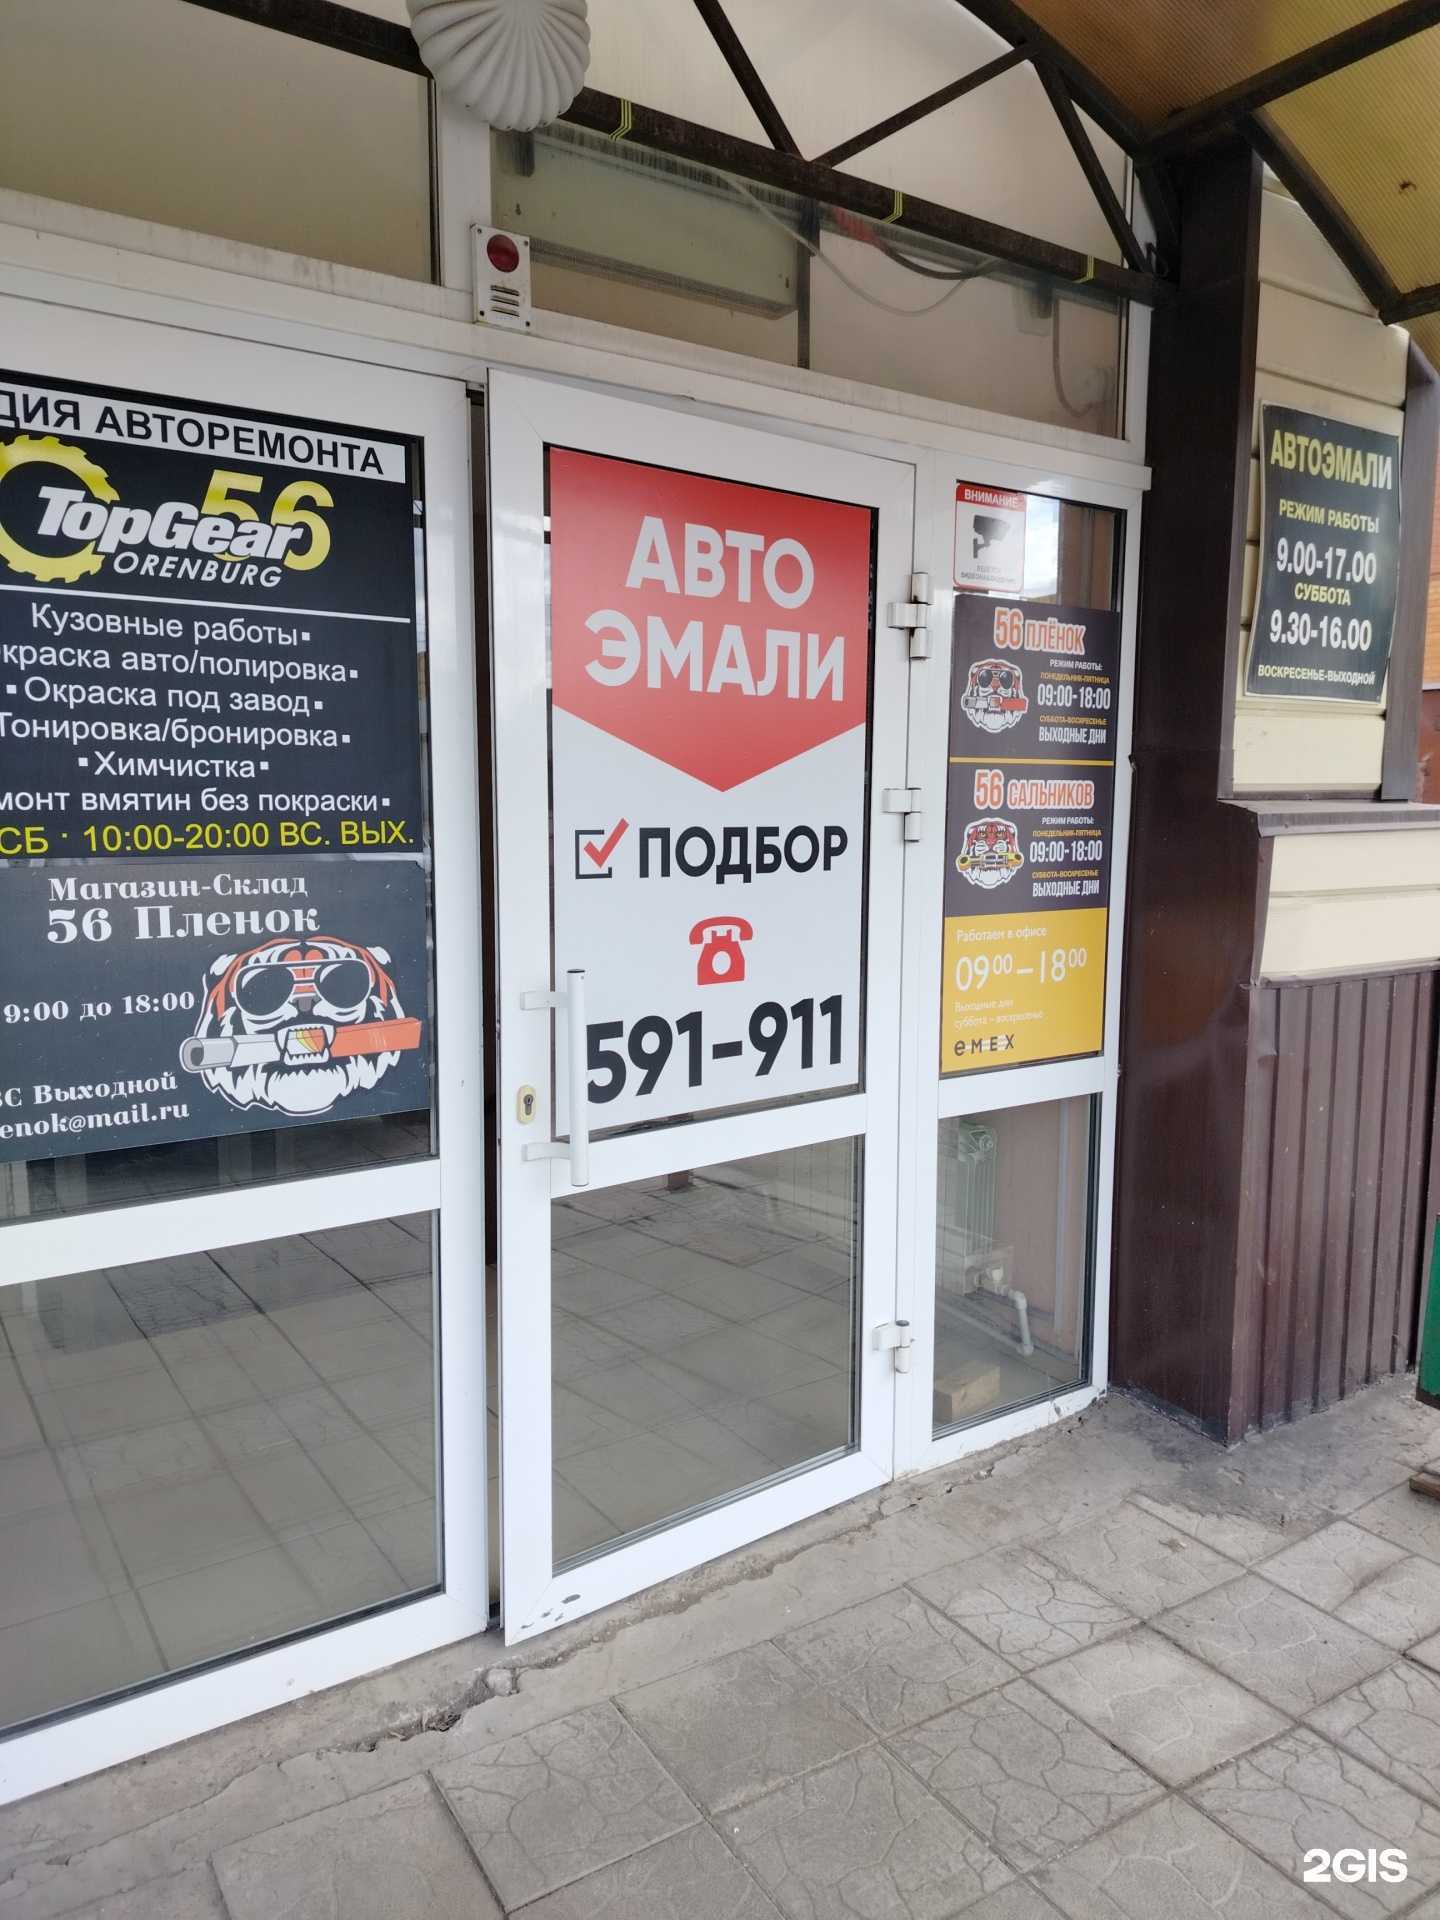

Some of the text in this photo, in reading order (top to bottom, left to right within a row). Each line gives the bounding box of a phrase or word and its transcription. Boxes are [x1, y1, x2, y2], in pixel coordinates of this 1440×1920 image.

[95, 406, 384, 475] АВТОРЕМОНТА
[1270, 429, 1393, 490] АВТОЭМАЛИ
[964, 488, 1018, 508] ВНИМАНИЕ
[1279, 498, 1379, 534] РЕЖИМ РАБОТЫ
[37, 485, 304, 559] TopGear
[200, 469, 334, 570] 56
[112, 551, 283, 588] ORENBURG
[625, 515, 815, 609] АВТО
[1276, 537, 1377, 585] 9.00-17.00
[1295, 582, 1352, 606] СУББОТА
[31, 602, 298, 646] Кузовные работы
[994, 606, 1086, 655] 56 ПЛЁНОК
[1269, 609, 1372, 652] 9.30-16.00
[0, 643, 346, 683] краска авто/полировка
[584, 609, 845, 702] ЭМАЛИ
[1049, 658, 1074, 669] РЕЖИМ
[1257, 664, 1376, 686] ВОСКРЕСЕНЬЕ-ВЫХОДНОЙ
[24, 676, 310, 717] Окраска под завод
[0, 711, 338, 750] Тонировка/бронировка
[1039, 727, 1106, 745] ВЫХОДНЫЕ ДНИ
[94, 751, 256, 778] Химчистка
[81, 792, 191, 811] вмятин
[201, 787, 249, 811] без
[258, 793, 378, 816] покраски
[974, 769, 1095, 810] 56 САЛЬНИКОВ
[0, 820, 414, 855] СБ 10:00-20:00 ВС. ВЫХ.
[1041, 816, 1066, 825] РЕЖИМ
[639, 825, 848, 884] ПОДБОР
[48, 873, 308, 902] Магазин-Склад
[1032, 879, 1100, 898] ВЫХОДНЫЕ ДНИ
[47, 905, 321, 944] 56 Пленок
[956, 927, 1005, 943] Работаем
[4, 991, 196, 1025] 9:00 до 18:00
[586, 994, 843, 1104] 591-911
[0, 1071, 178, 1108] С Выходной
[0, 1101, 190, 1139] enok@mail.ru
